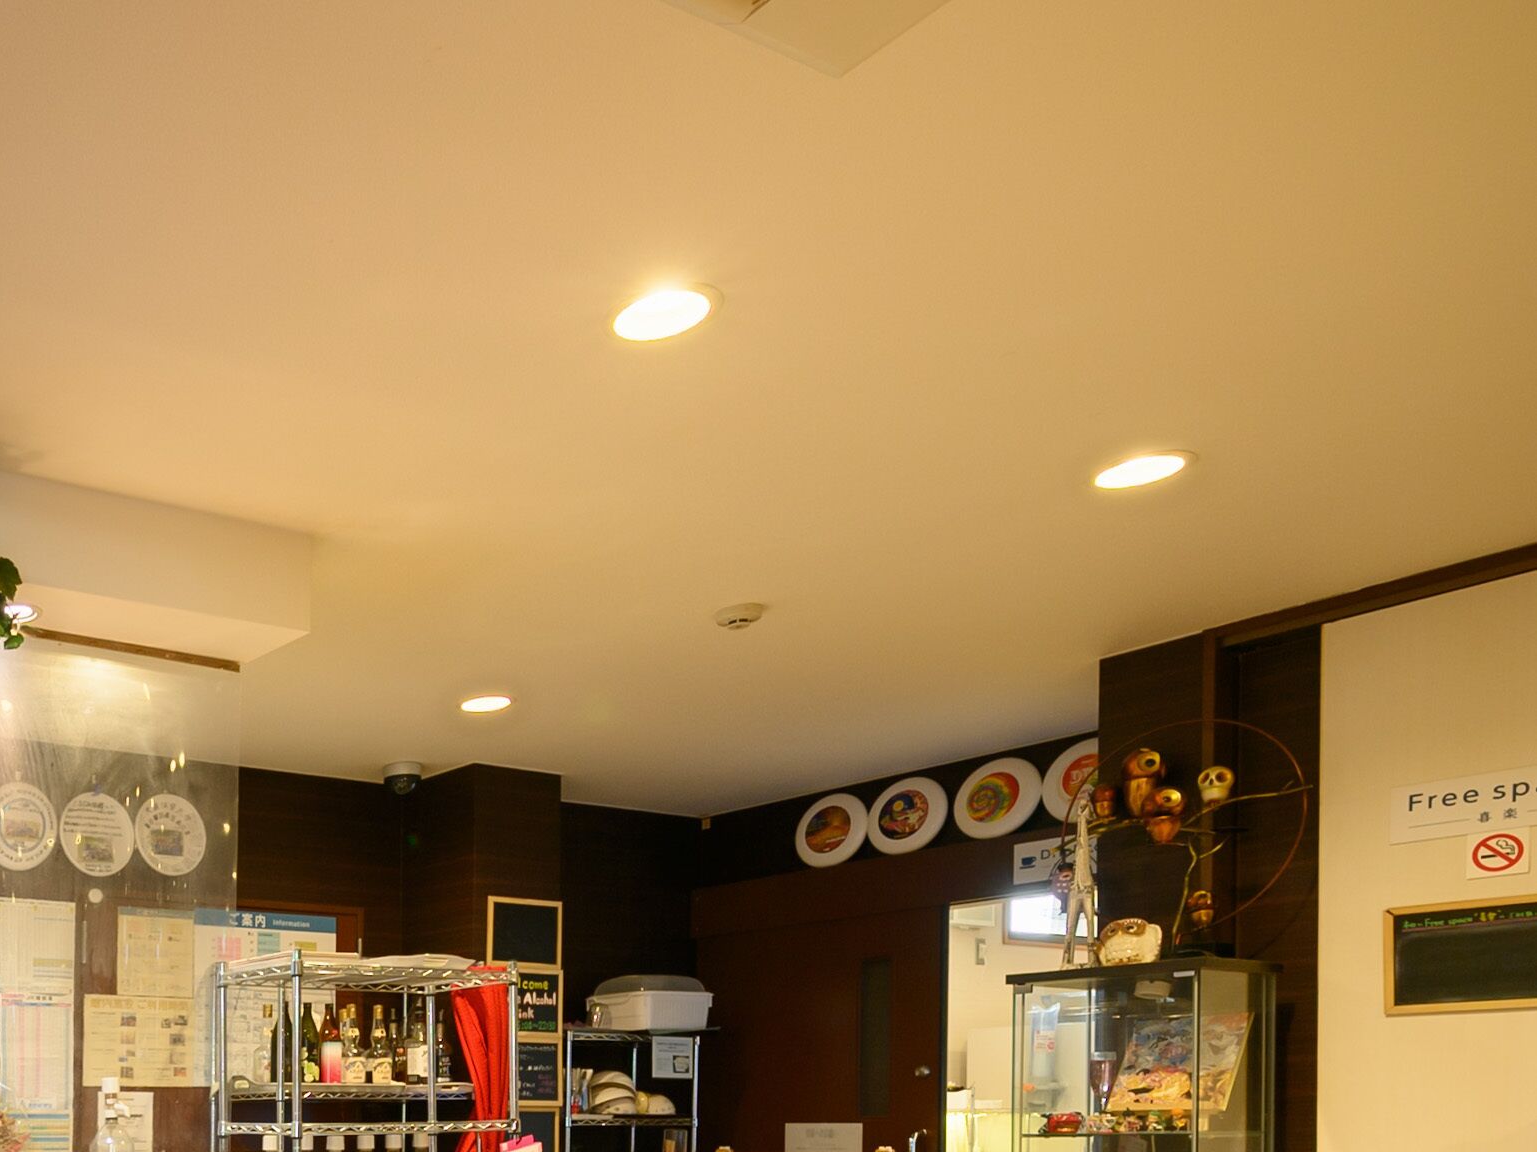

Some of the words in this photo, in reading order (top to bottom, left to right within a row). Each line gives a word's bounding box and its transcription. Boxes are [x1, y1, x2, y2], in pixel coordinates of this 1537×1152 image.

[1408, 788, 1480, 812] Free
[1493, 781, 1537, 803] sp
[229, 912, 266, 929] ご案内
[272, 918, 310, 929] Information
